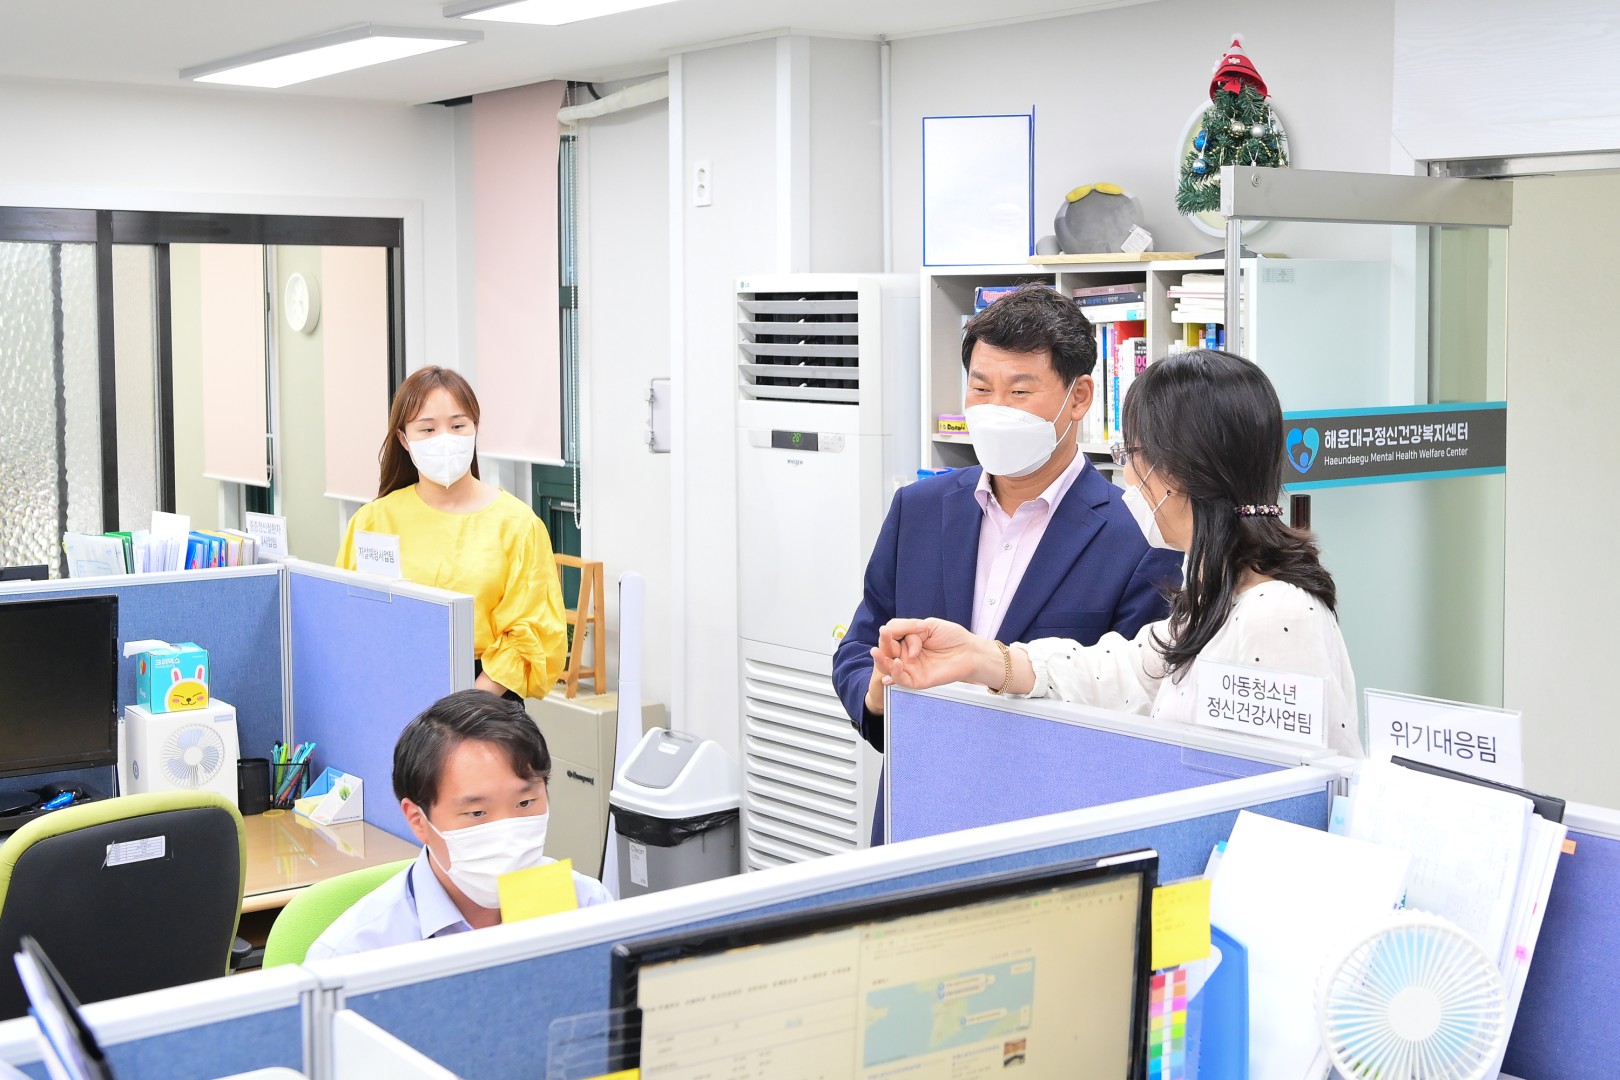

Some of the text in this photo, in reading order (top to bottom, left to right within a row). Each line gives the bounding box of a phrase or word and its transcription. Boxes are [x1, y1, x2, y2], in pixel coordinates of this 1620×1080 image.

[1324, 421, 1469, 449] 해운대구정신건강복지센터
[1324, 447, 1469, 466] Haeundaegu Mental Health Welfare Center
[358, 546, 395, 563] 자살예방사업팀
[1222, 674, 1297, 706] 아동청소년
[1207, 696, 1312, 735] 정신건강사업팀
[1390, 720, 1497, 764] 위기대응팀
